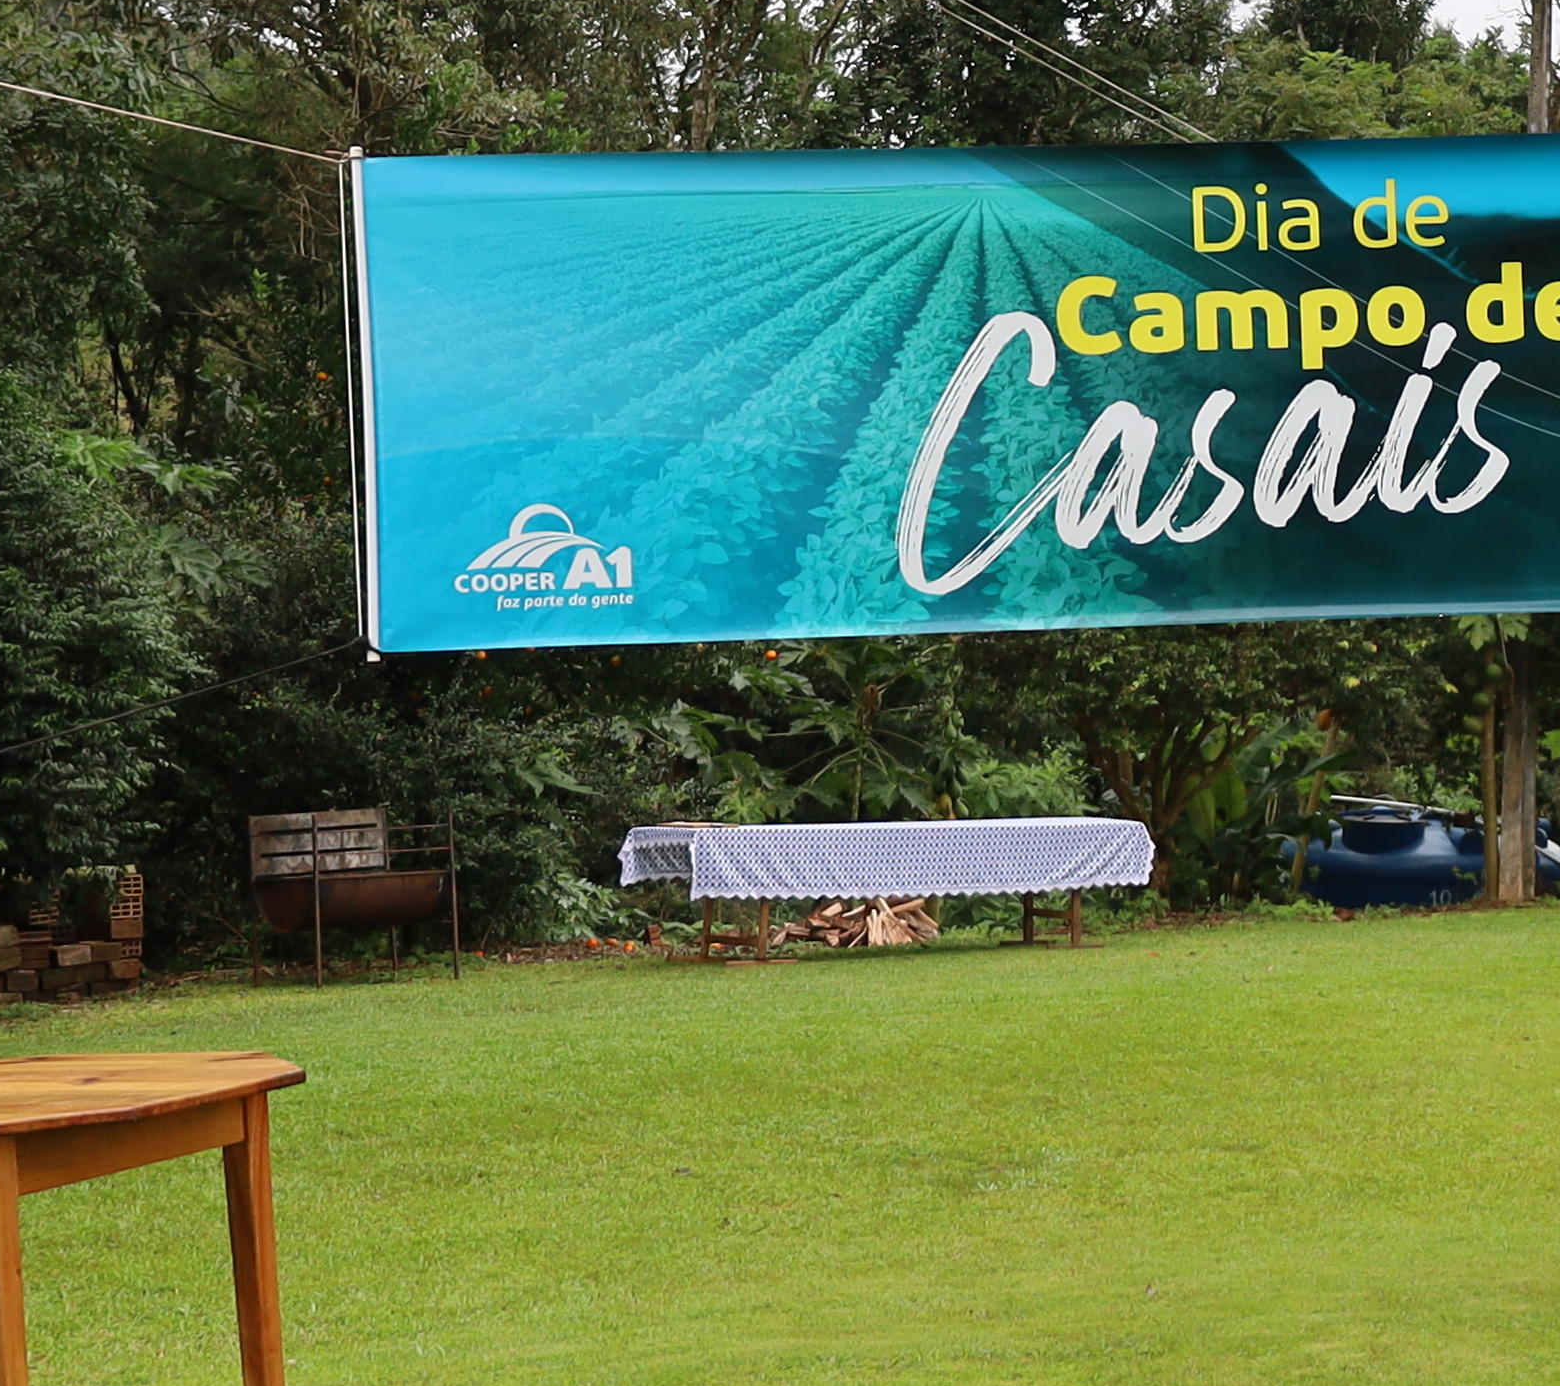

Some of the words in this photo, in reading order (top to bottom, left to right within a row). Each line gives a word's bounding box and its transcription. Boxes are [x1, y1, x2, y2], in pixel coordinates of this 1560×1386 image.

[1192, 182, 1321, 252] Dia
[1353, 178, 1449, 248] de
[1056, 276, 1426, 369] Campo
[894, 311, 1510, 595] Casais
[454, 572, 556, 593] COOPER
[563, 546, 633, 590] A1
[497, 595, 520, 611] faz
[524, 595, 564, 611] parte
[568, 593, 587, 606] da
[591, 593, 634, 609] gente
